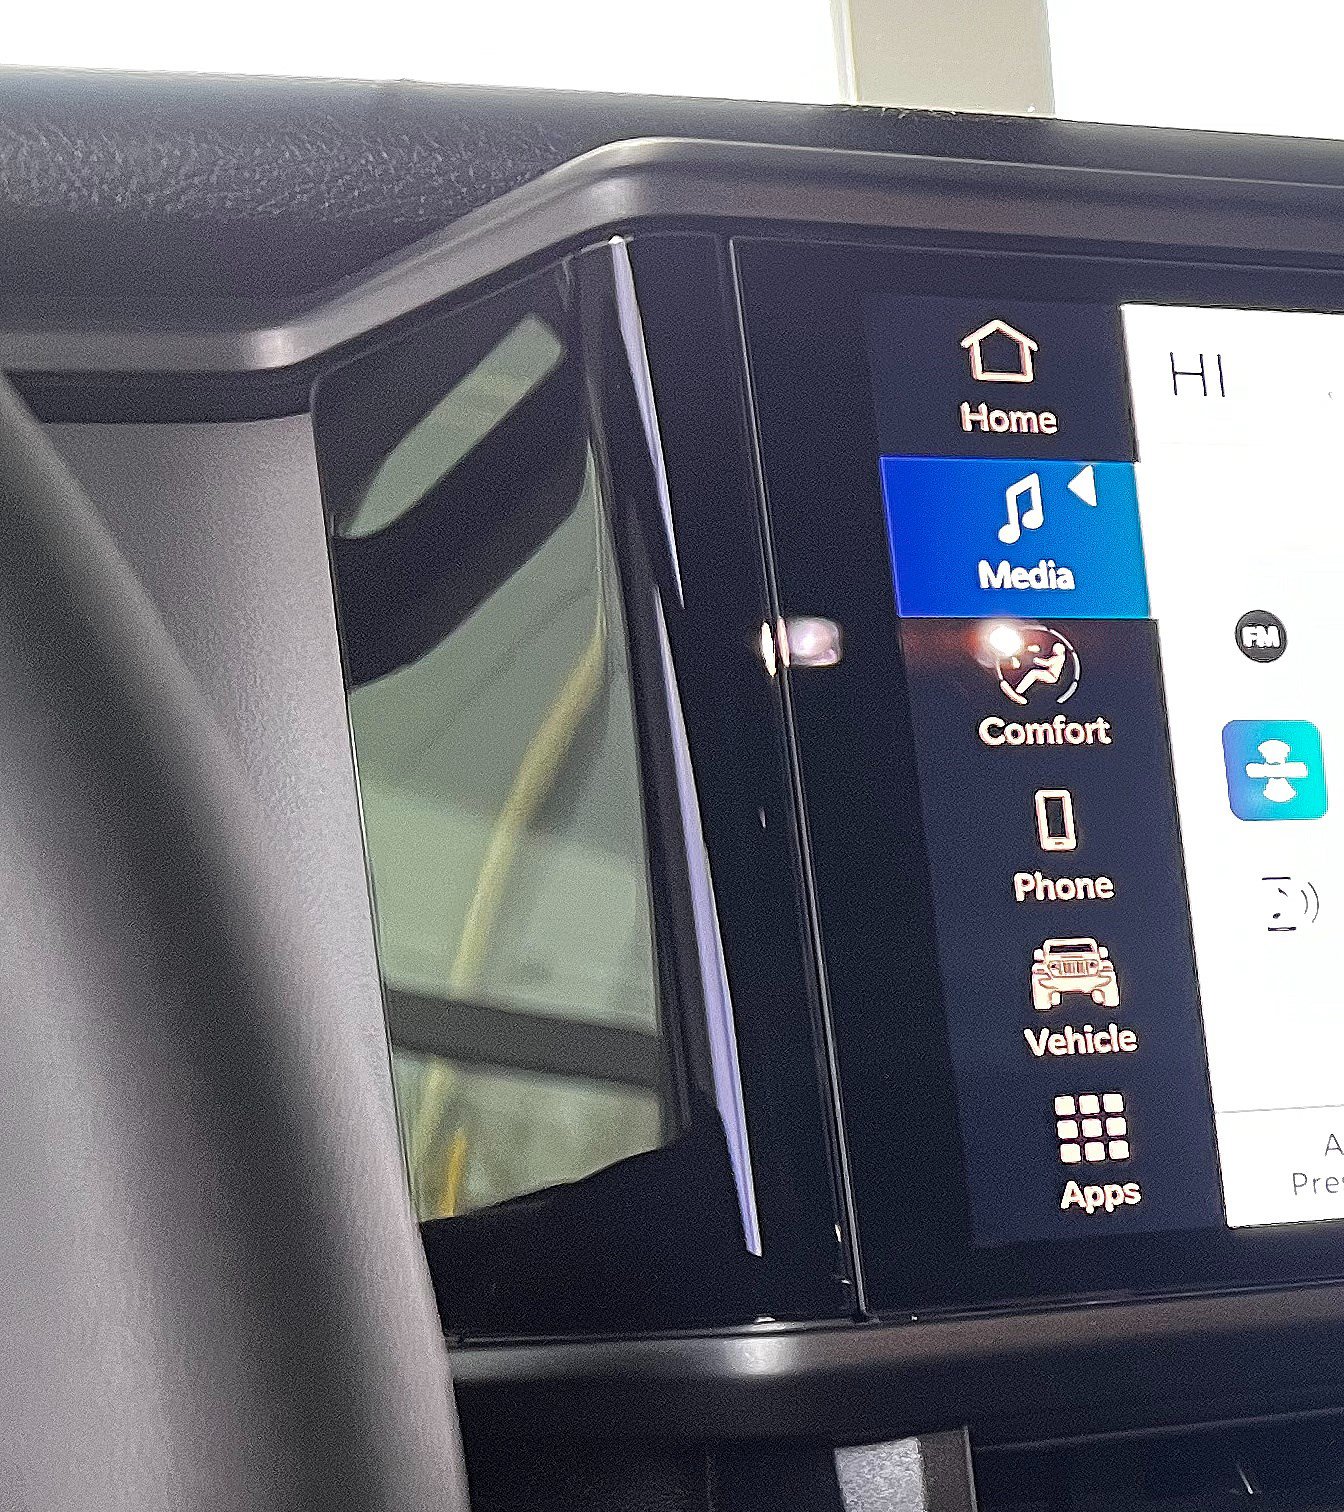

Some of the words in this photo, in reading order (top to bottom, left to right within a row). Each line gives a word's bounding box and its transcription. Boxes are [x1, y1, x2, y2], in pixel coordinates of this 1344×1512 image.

[1169, 352, 1226, 398] HI
[959, 402, 1058, 435] Home
[977, 561, 1075, 591] Media
[1241, 625, 1282, 649] FM
[978, 716, 1111, 746] Comfort
[1013, 872, 1115, 901] Phone
[1024, 1025, 1138, 1057] Vehicle
[1060, 1181, 1141, 1214] Apps
